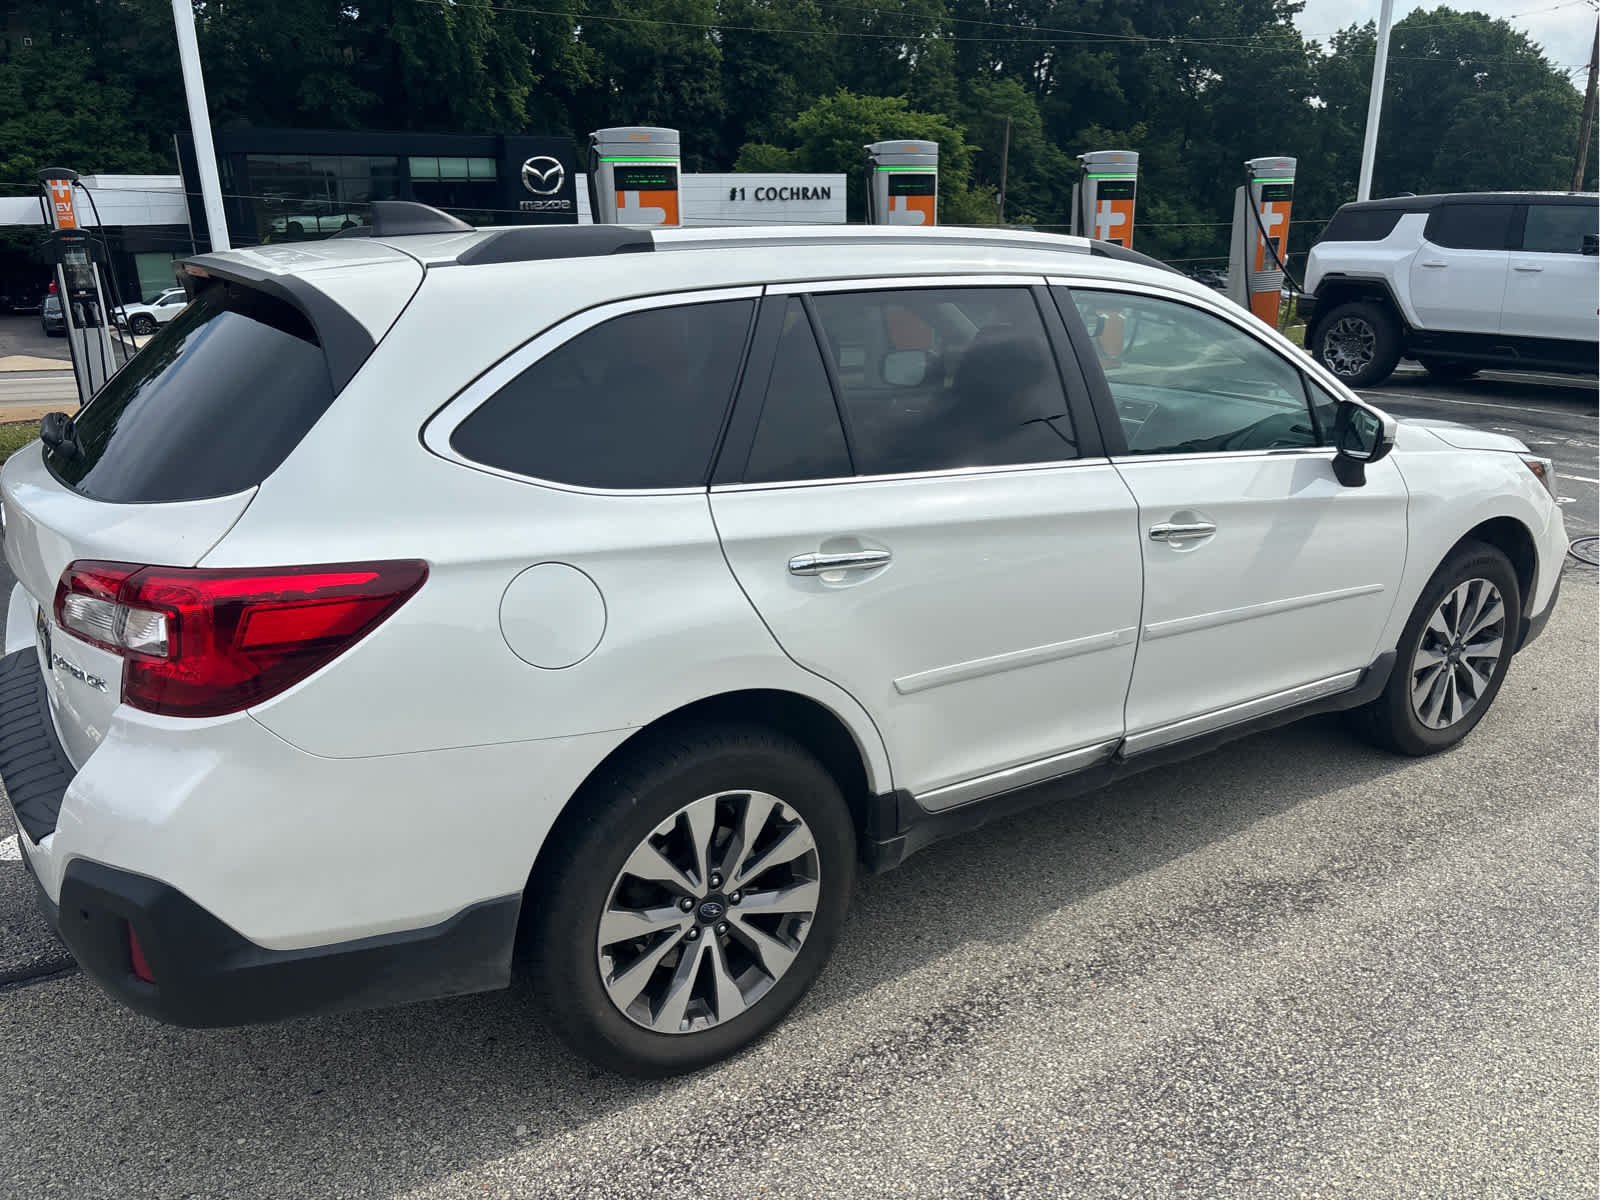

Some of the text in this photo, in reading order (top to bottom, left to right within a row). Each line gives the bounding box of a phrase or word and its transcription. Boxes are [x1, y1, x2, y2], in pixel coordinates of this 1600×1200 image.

[729, 186, 831, 201] #1 COCHRAN
[55, 202, 71, 212] EV
